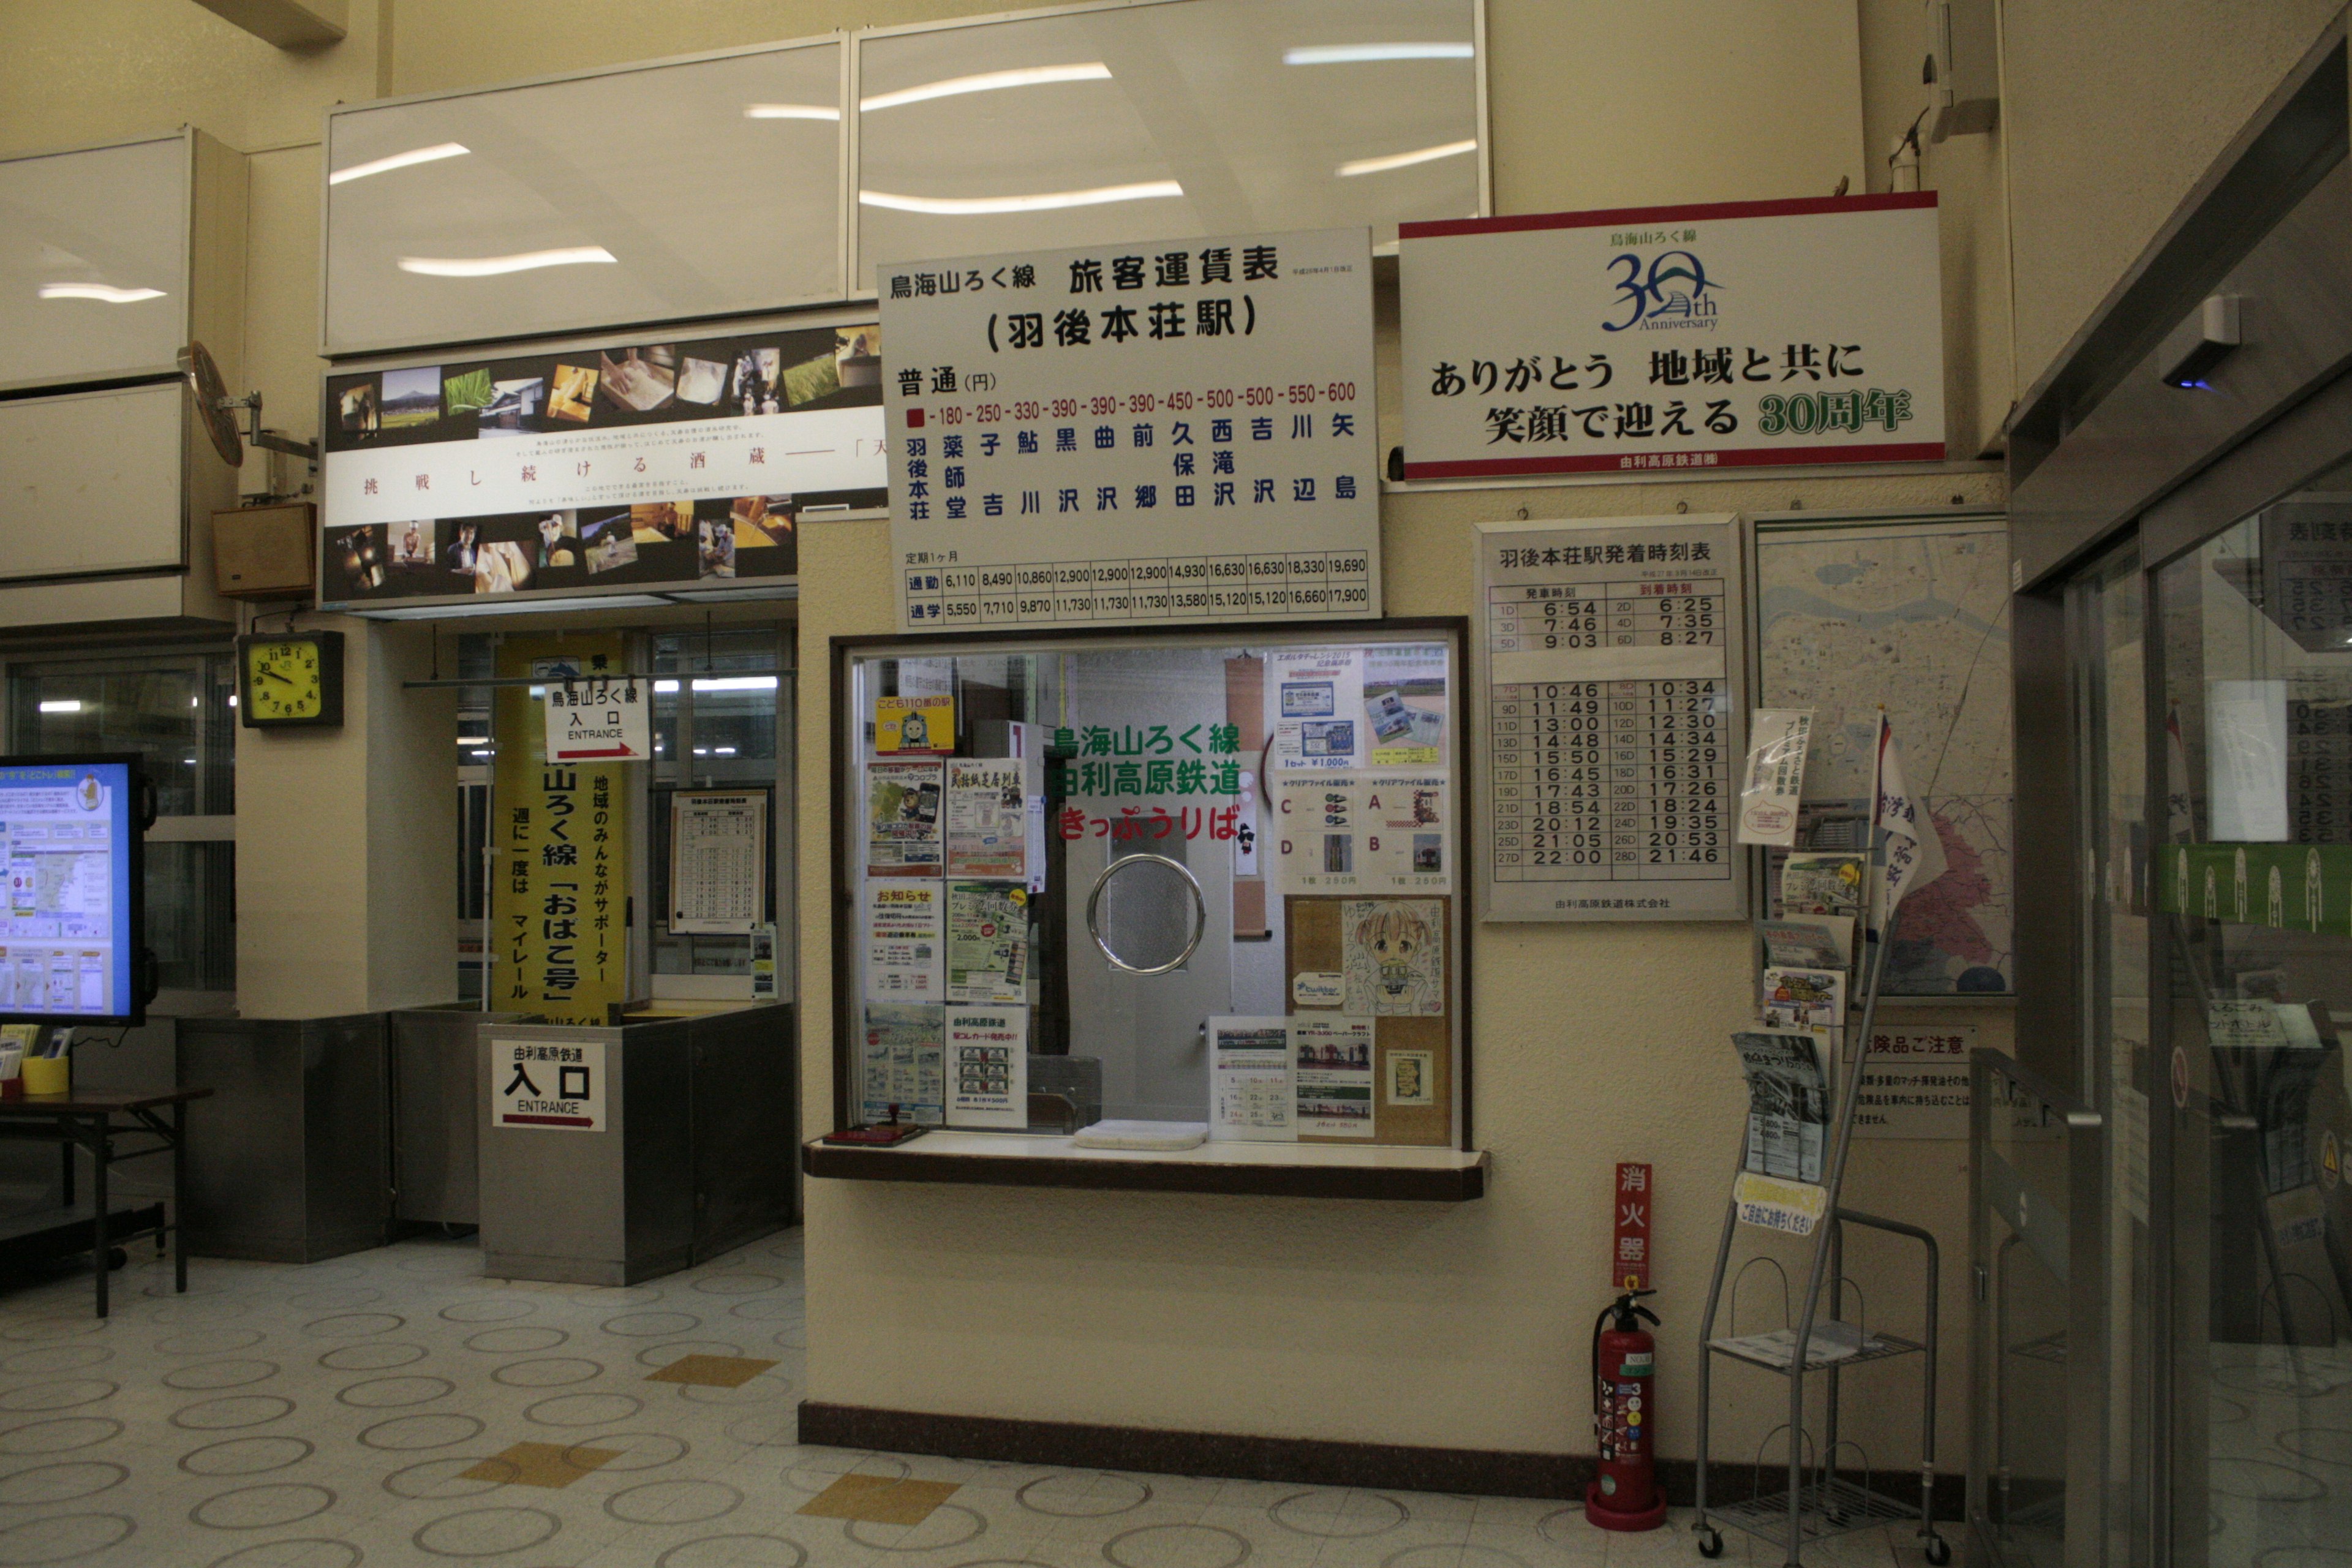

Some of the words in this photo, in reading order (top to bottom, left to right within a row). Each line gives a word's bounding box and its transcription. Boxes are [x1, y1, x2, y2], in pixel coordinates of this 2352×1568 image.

[1610, 229, 1697, 246] 鳥海山ろく線
[891, 264, 1036, 299] 鳥海山ろく線
[1069, 246, 1278, 293] 旅客運賃表
[987, 295, 1255, 353] (羽後本荘駅)
[1639, 318, 1718, 331] Anniversary
[1430, 353, 1613, 398] ありがとう
[1649, 343, 1864, 386] 地域と共に
[940, 407, 962, 425] 180
[976, 404, 1001, 423] 250
[1014, 401, 1039, 420] 330
[1052, 398, 1077, 418] 390
[1091, 396, 1116, 415] 390
[1129, 394, 1155, 413] 390
[1167, 391, 1193, 410] 450
[1207, 389, 1234, 409] 500
[1246, 386, 1273, 406] 500
[1289, 384, 1315, 404] 550
[1328, 382, 1355, 402] 600
[1484, 399, 1738, 445] 笑顔で迎える
[1758, 388, 1913, 436] 30周年
[1171, 421, 1195, 507] 久保田
[1211, 418, 1235, 507] 西滝沢
[907, 437, 930, 521] 羽後本荘
[943, 434, 967, 519] 薬師堂
[1499, 542, 1711, 568] 羽後本荘駅発着時刻表
[909, 575, 939, 590] 通勤
[946, 574, 976, 588] 6,110
[982, 572, 1012, 586] 8,490
[1017, 570, 1052, 586] 10,860
[1054, 569, 1090, 583] 12,900
[1092, 568, 1128, 582] 12,900
[1130, 565, 1167, 581] 12,900
[1169, 564, 1206, 579] 14,930
[1209, 563, 1245, 578] 16,630
[1248, 562, 1284, 576] 16,630
[1287, 560, 1325, 575] 18,330
[1329, 559, 1365, 573] 19,690
[1526, 587, 1577, 599] 発車時刻
[1640, 583, 1692, 595] 到着時刻
[910, 603, 941, 619] 通学
[947, 603, 977, 617] 5,550
[984, 601, 1014, 616] 7,710
[1020, 600, 1051, 614] 9,870
[1056, 598, 1091, 612] 11,730
[1094, 597, 1129, 611] 11,730
[1132, 595, 1168, 609] 11,730
[1170, 594, 1207, 608] 13,580
[1210, 592, 1246, 606] 15,120
[1249, 591, 1286, 606] 15,120
[1289, 590, 1326, 605] 16,660
[1329, 589, 1366, 603] 17,900
[1544, 601, 1597, 617] 6:54
[1659, 598, 1713, 612] 6:25
[1544, 617, 1597, 632] 7:46
[1660, 614, 1713, 628] 7:35
[1545, 634, 1597, 649] 9:03
[1660, 631, 1714, 646] 8:27
[552, 687, 638, 707] 鳥海山ろく線
[1532, 684, 1598, 699] 10:46
[1649, 681, 1715, 696] 10:34
[1532, 701, 1598, 715] 11:49
[1649, 698, 1715, 712] 11:27
[1533, 717, 1599, 732] 13:00
[1650, 714, 1716, 729] 12:30
[568, 729, 623, 740] ENTRANCE
[1054, 723, 1240, 760] 鳥海山ろく線
[1534, 734, 1599, 748] 14:48
[1650, 731, 1716, 746] 14:34
[1534, 750, 1599, 765] 15:50
[1650, 748, 1716, 763] 15:29
[1052, 759, 1241, 796] 由利高原鉄道
[1534, 767, 1600, 782] 16:45
[1651, 764, 1715, 780] 16:31
[1534, 784, 1600, 799] 17:43
[1651, 782, 1717, 796] 17:26
[1281, 799, 1292, 814] C
[1368, 794, 1381, 810] A
[1535, 800, 1600, 815] 18:54
[1651, 798, 1717, 813] 18:24
[1059, 804, 1240, 840] きっぷうりば
[1532, 816, 1600, 832] 20:12
[1651, 815, 1717, 829] 19:35
[1281, 840, 1292, 854] D
[1370, 837, 1380, 851] B
[1533, 834, 1601, 848] 21:05
[1649, 832, 1717, 846] 20:53
[511, 807, 530, 894] 週に一度は
[1534, 850, 1602, 865] 22:00
[1649, 848, 1718, 863] 21:46
[593, 775, 609, 982] 地域のみんながサポーター
[877, 891, 930, 902] お知らせ
[1555, 898, 1671, 910] 由利高原鉄道株式会社
[511, 914, 529, 1000] マイレール
[954, 1017, 1005, 1028] 由利高原鉄道
[514, 1045, 583, 1062] 由利高原鉄道
[504, 1063, 590, 1100] 入口
[518, 1100, 579, 1114] ENTRANCE
[1619, 1167, 1645, 1261] 消火器
